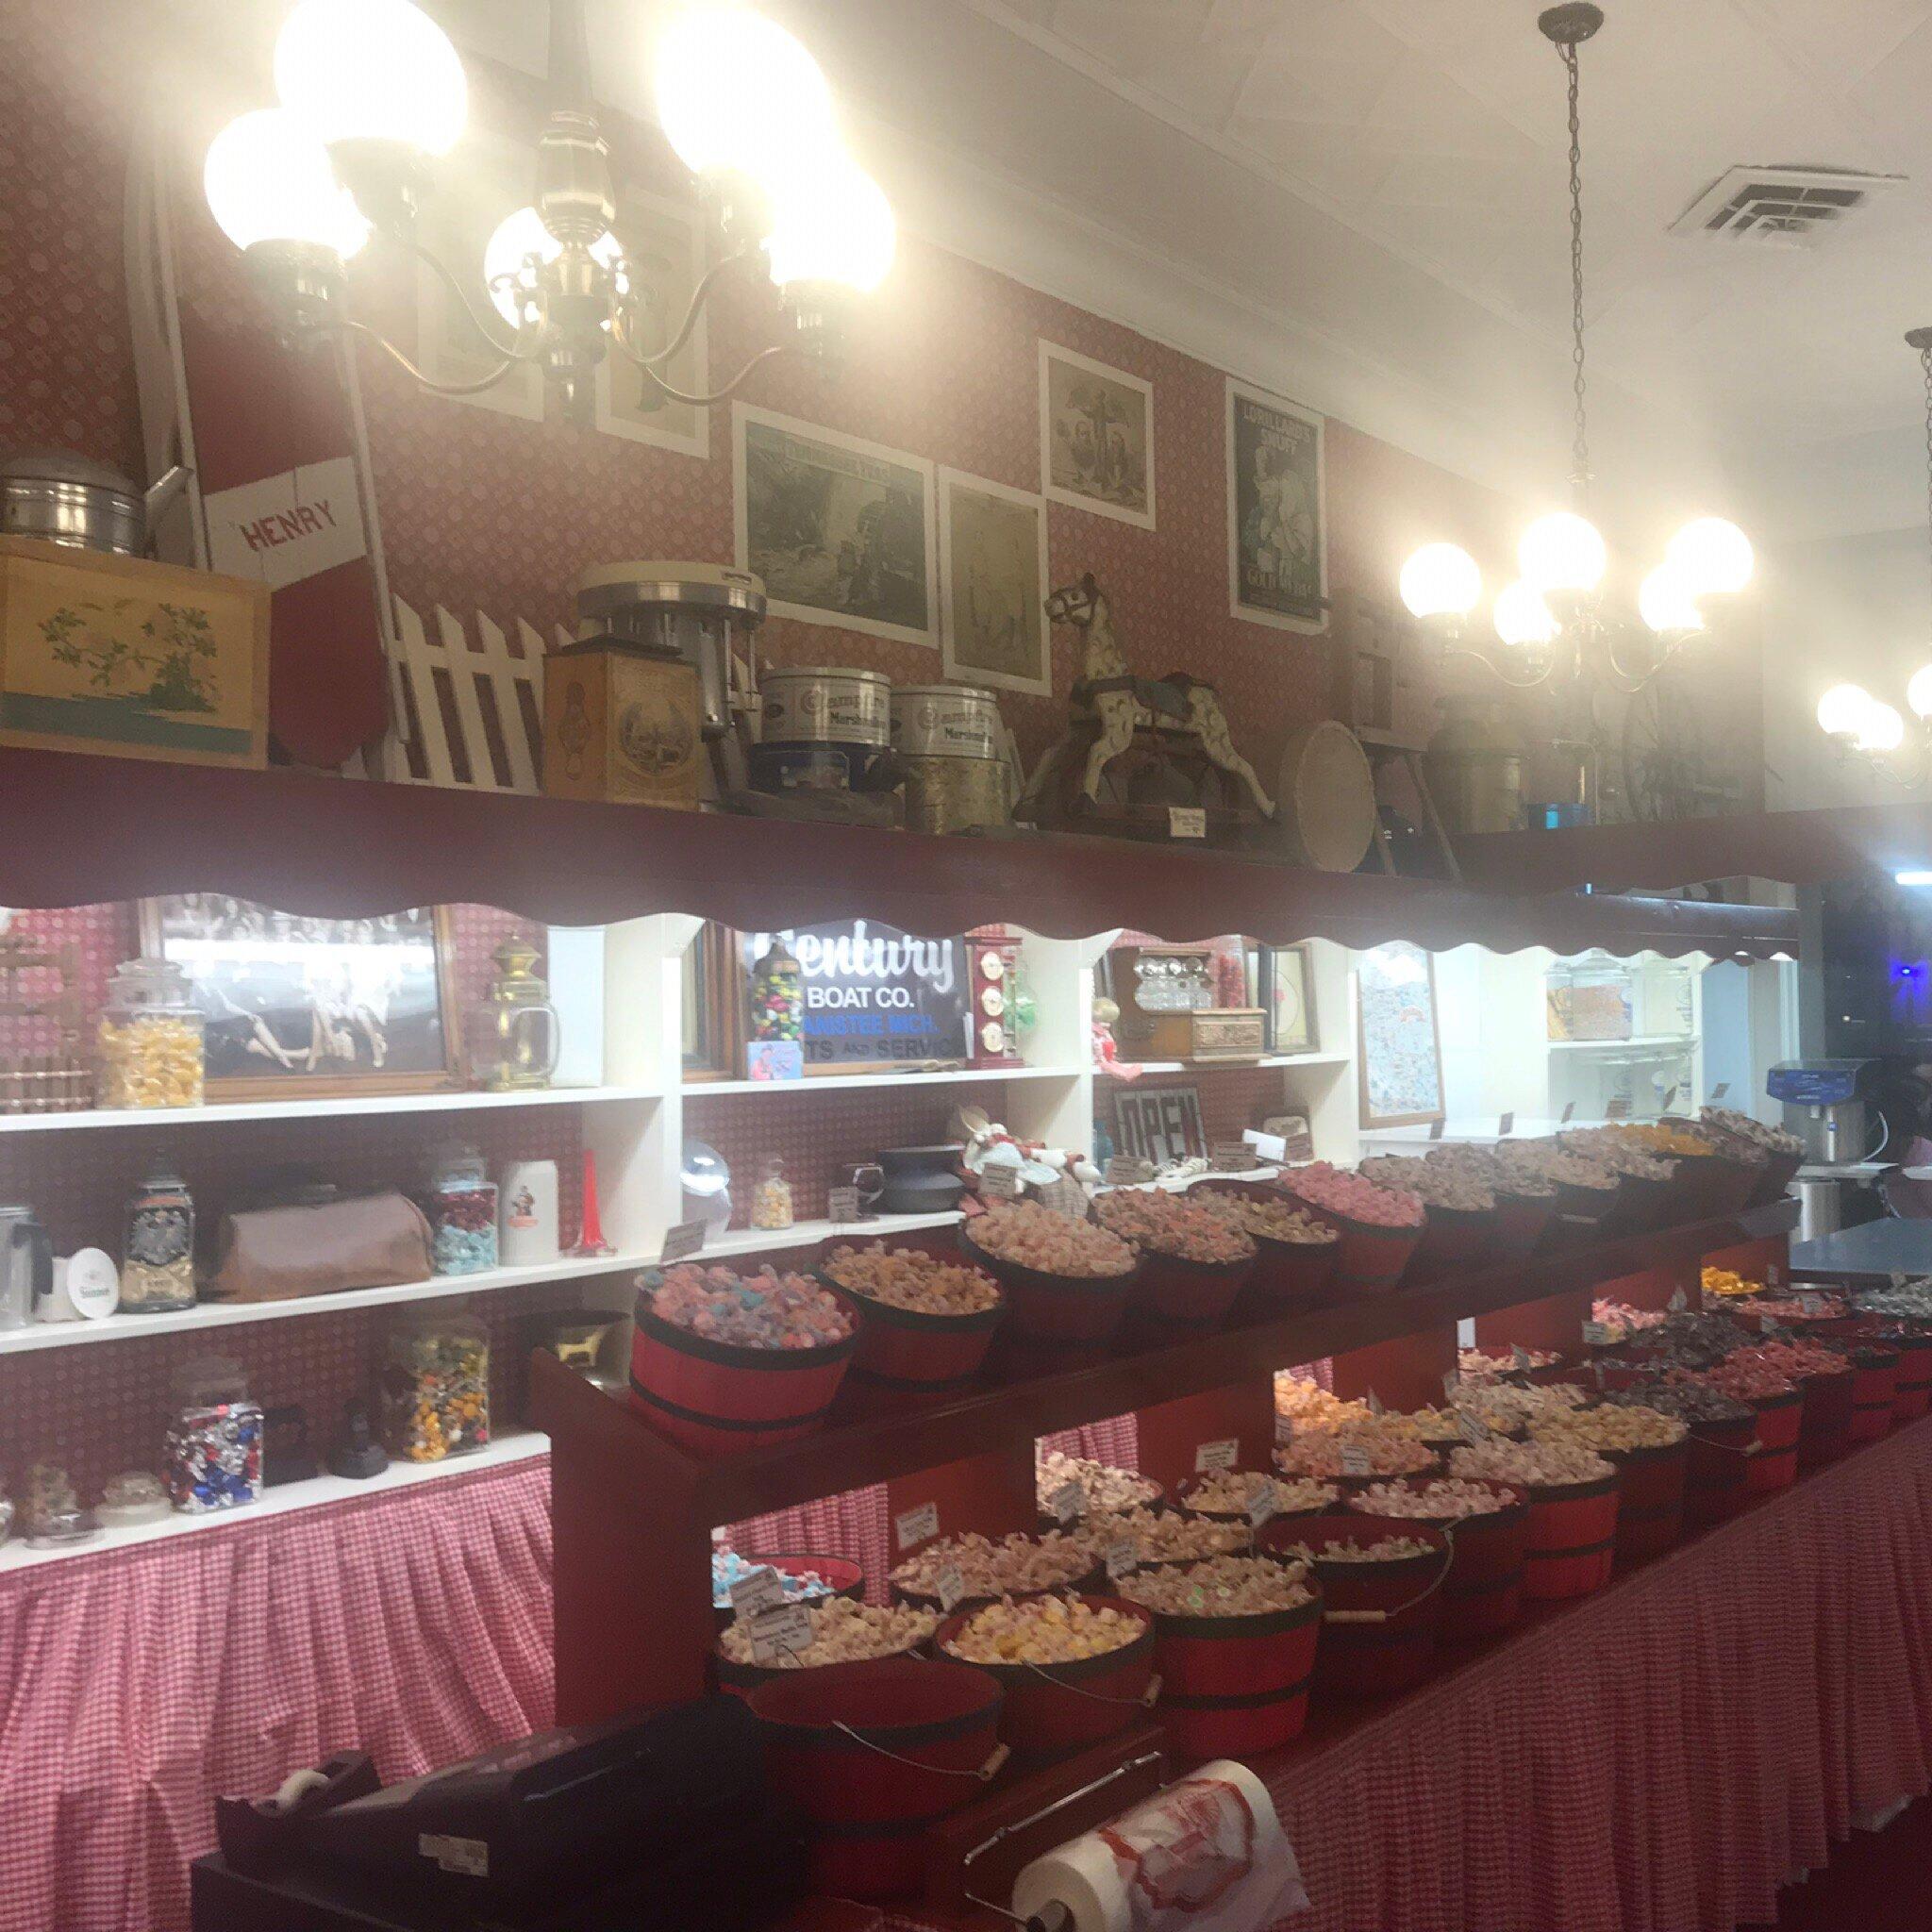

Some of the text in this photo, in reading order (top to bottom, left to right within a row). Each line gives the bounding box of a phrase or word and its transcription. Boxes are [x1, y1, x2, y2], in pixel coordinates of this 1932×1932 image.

[239, 498, 337, 552] HENRY
[807, 987, 915, 1008] BOAT CO.
[804, 1014, 884, 1035] ANISTEE
[806, 1039, 953, 1059] TS AND SERVIC
